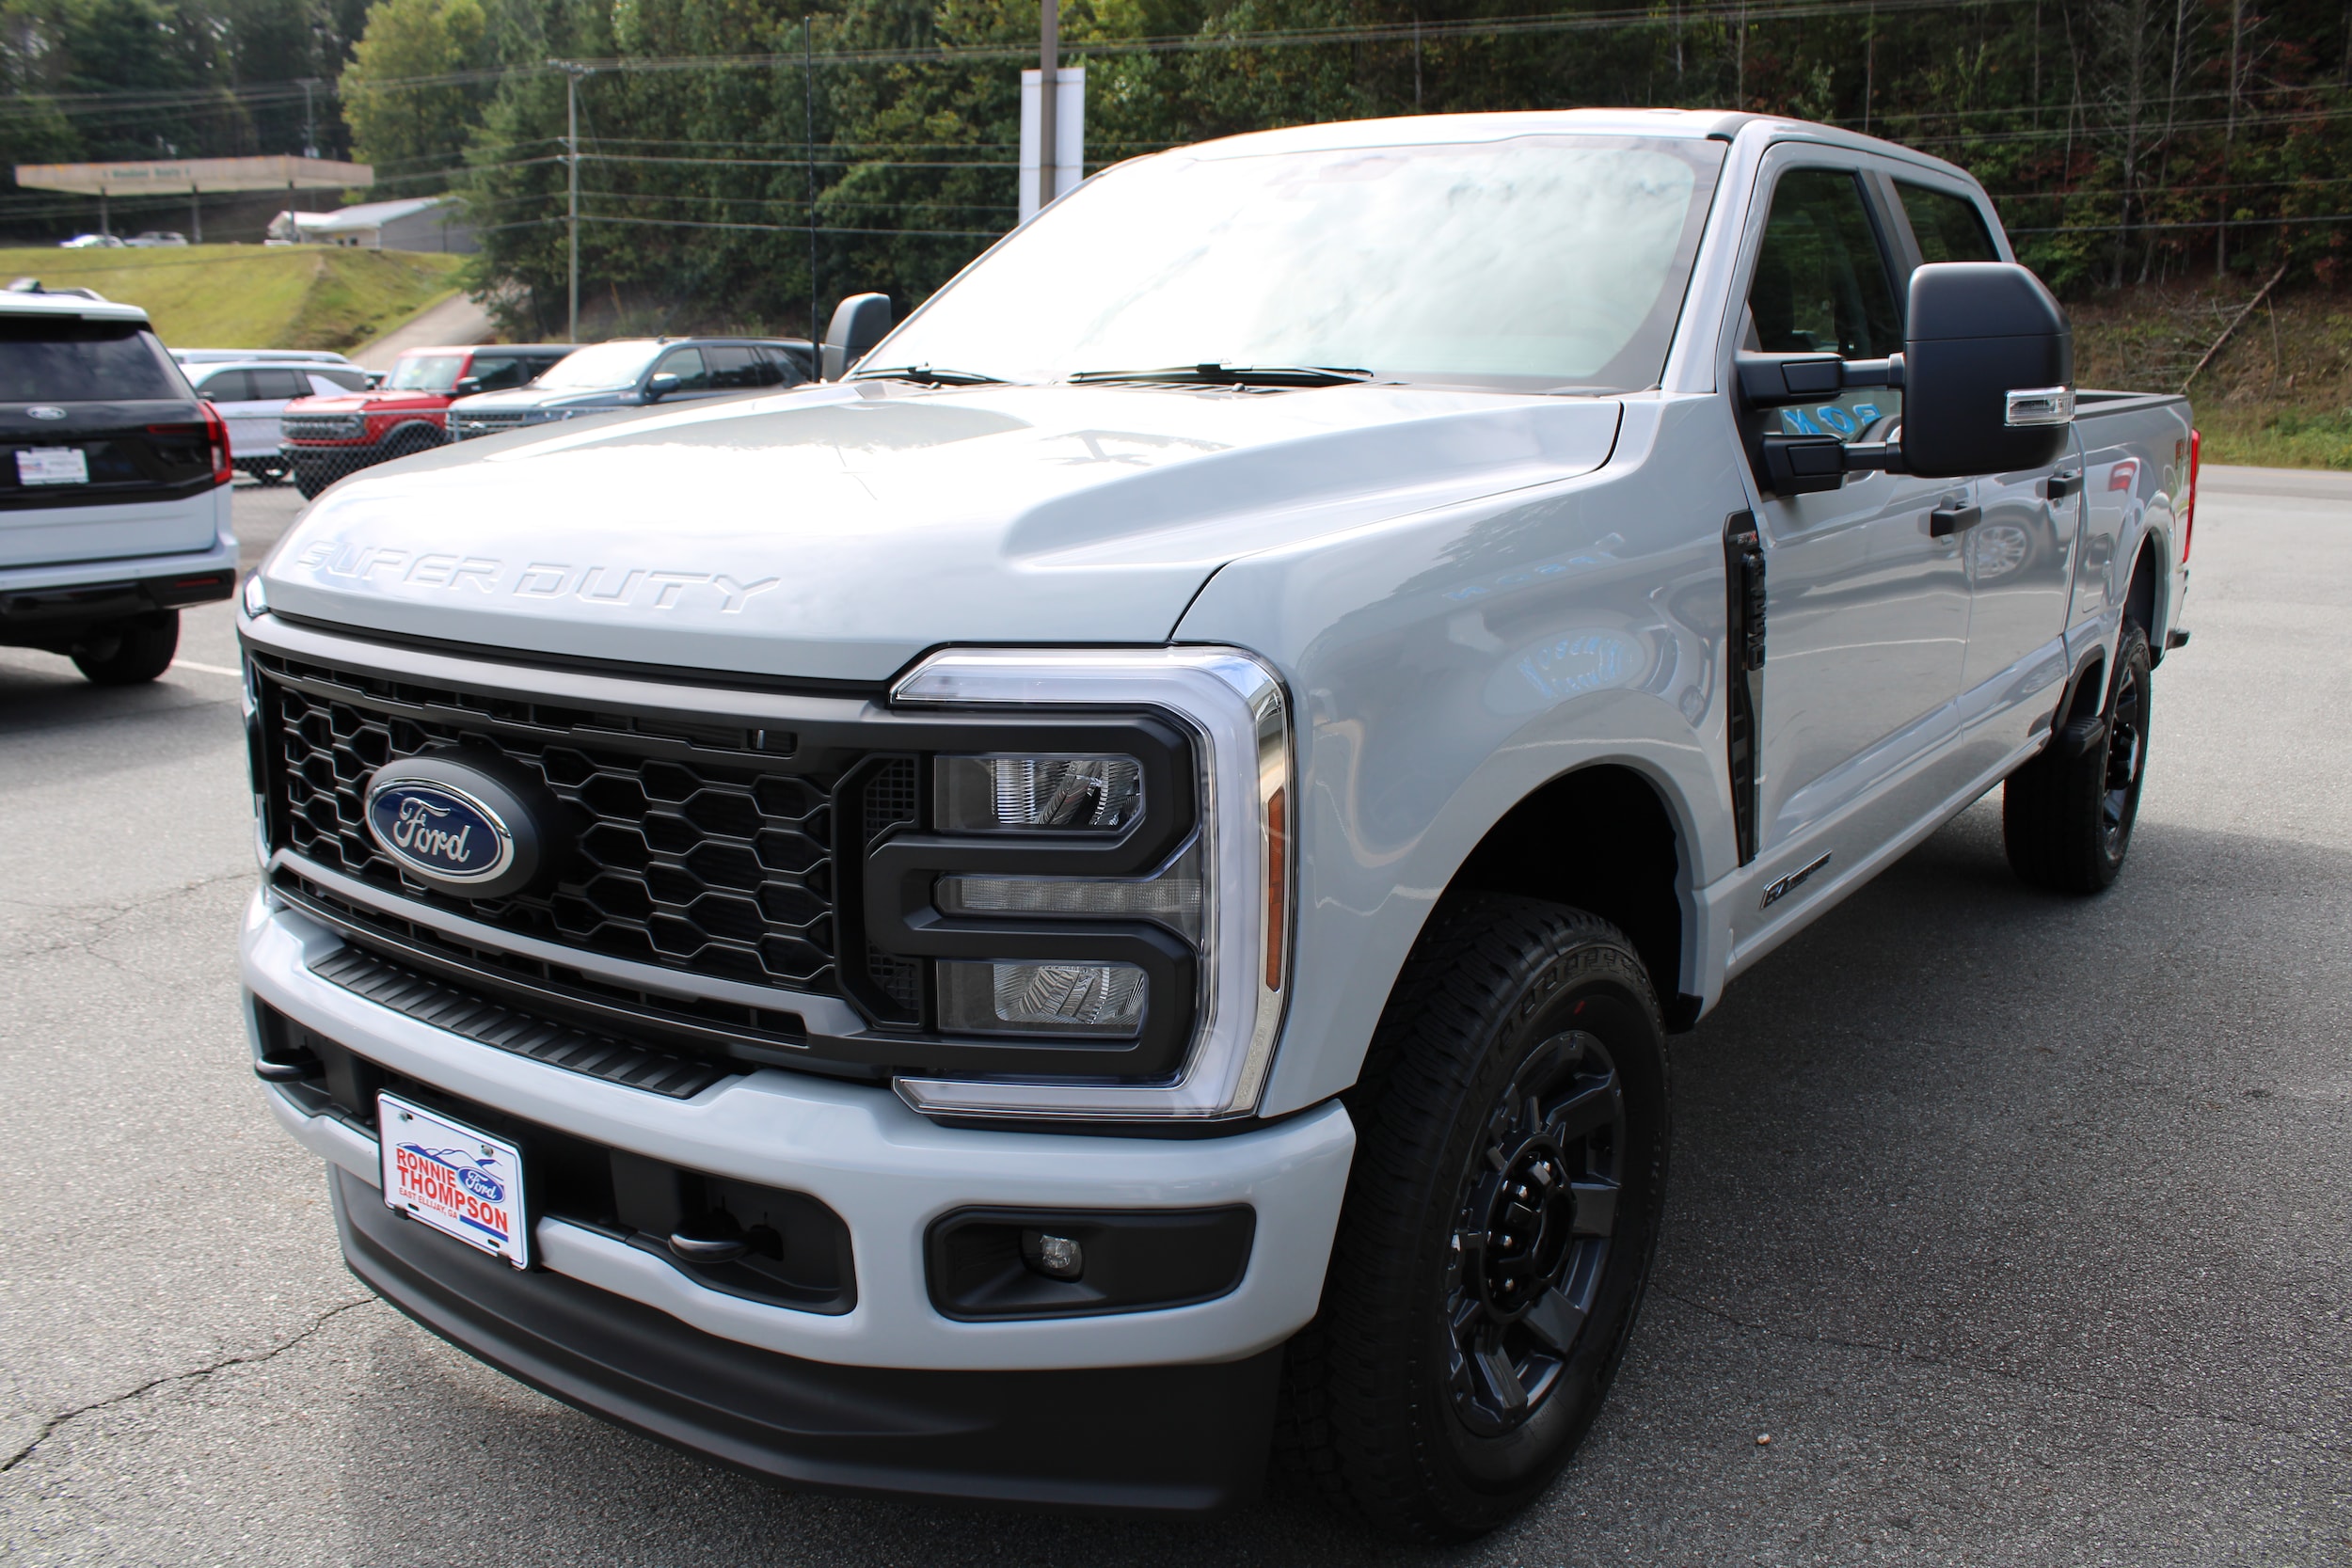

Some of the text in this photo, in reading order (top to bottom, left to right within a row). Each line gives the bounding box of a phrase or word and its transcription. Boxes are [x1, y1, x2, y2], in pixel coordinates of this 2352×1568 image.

[296, 540, 781, 613] SUPER DUTY
[393, 797, 471, 863] Ford
[396, 1148, 456, 1188] RONNIE
[465, 1170, 498, 1199] Ford
[397, 1165, 508, 1233] THOMPSON
[399, 1187, 416, 1200] EAST
[448, 1209, 457, 1219] GA
